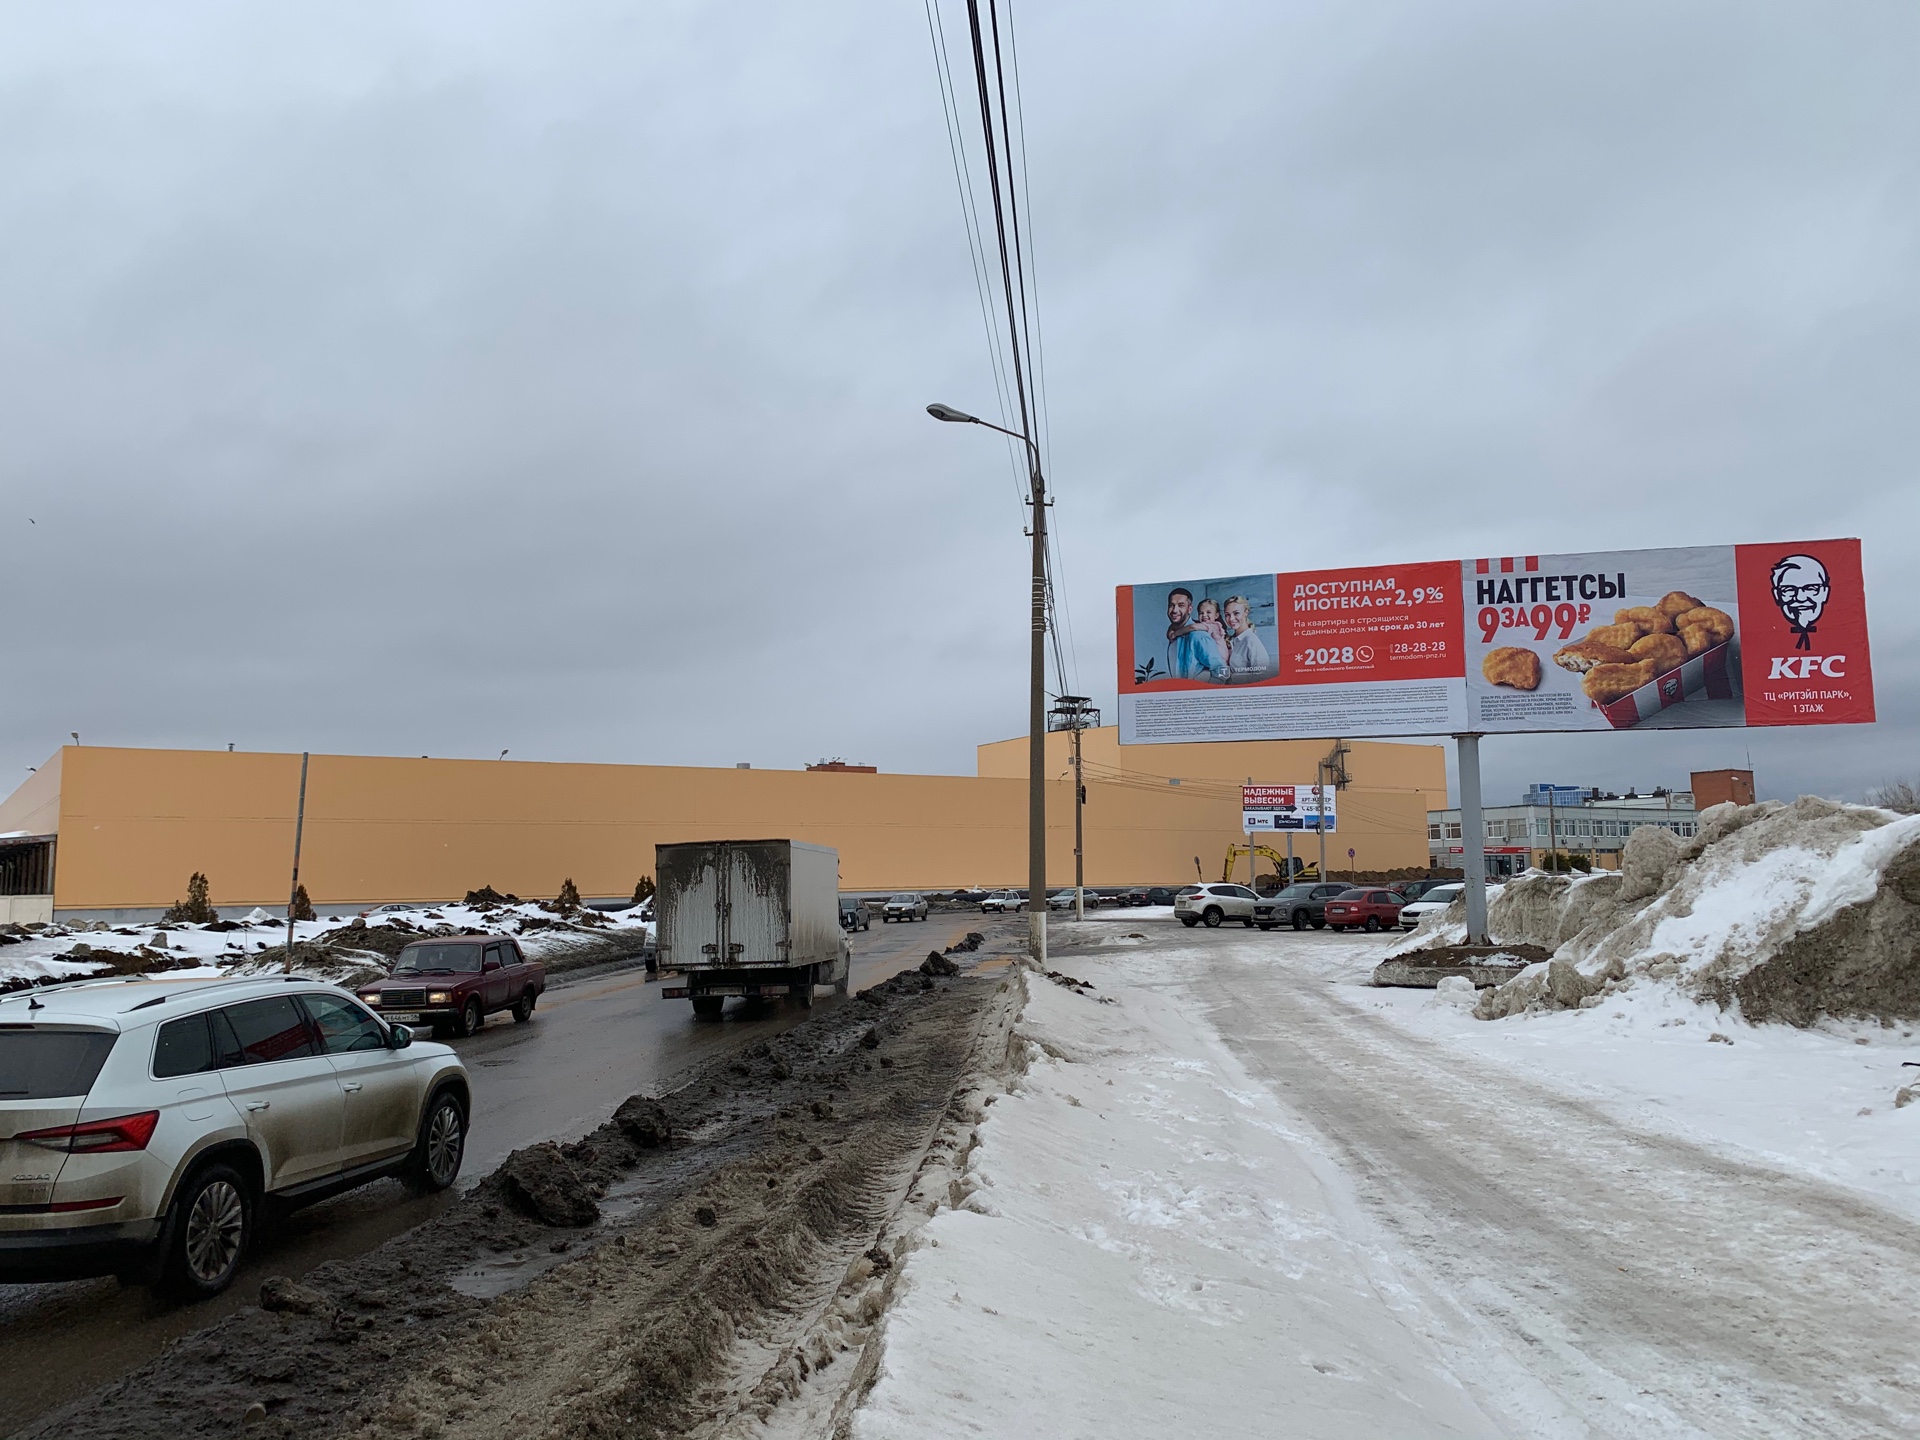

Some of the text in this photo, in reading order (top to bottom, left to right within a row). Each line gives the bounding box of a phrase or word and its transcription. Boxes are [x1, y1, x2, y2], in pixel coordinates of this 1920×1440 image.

[1293, 578, 1395, 598] ДОСТУПНАЯ
[1476, 573, 1626, 605] НАГГЕТСЫ
[1294, 596, 1372, 612] ИПОТЕКА
[1376, 597, 1392, 606] от
[1294, 620, 1306, 628] На
[1307, 616, 1348, 627] квартиры
[1357, 614, 1409, 625] строящихся
[1301, 628, 1337, 637] сданных
[1339, 626, 1366, 635] домах
[1380, 623, 1402, 634] срок
[1402, 622, 1414, 631] до
[1416, 621, 1427, 629] 30
[1429, 621, 1445, 629] лет
[1394, 641, 1446, 653] 28-28-28
[1389, 652, 1447, 661] termodom-pnz.ru
[1767, 654, 1846, 680] KFC
[1764, 692, 1776, 702] ТЦ
[1777, 689, 1818, 701] «РИТЭЙЛ
[1793, 703, 1824, 714] 1 ЭТАЖ
[1244, 788, 1293, 796] НАДЕЖНЫЕ
[1244, 797, 1284, 805] ВЫВЕСКИ
